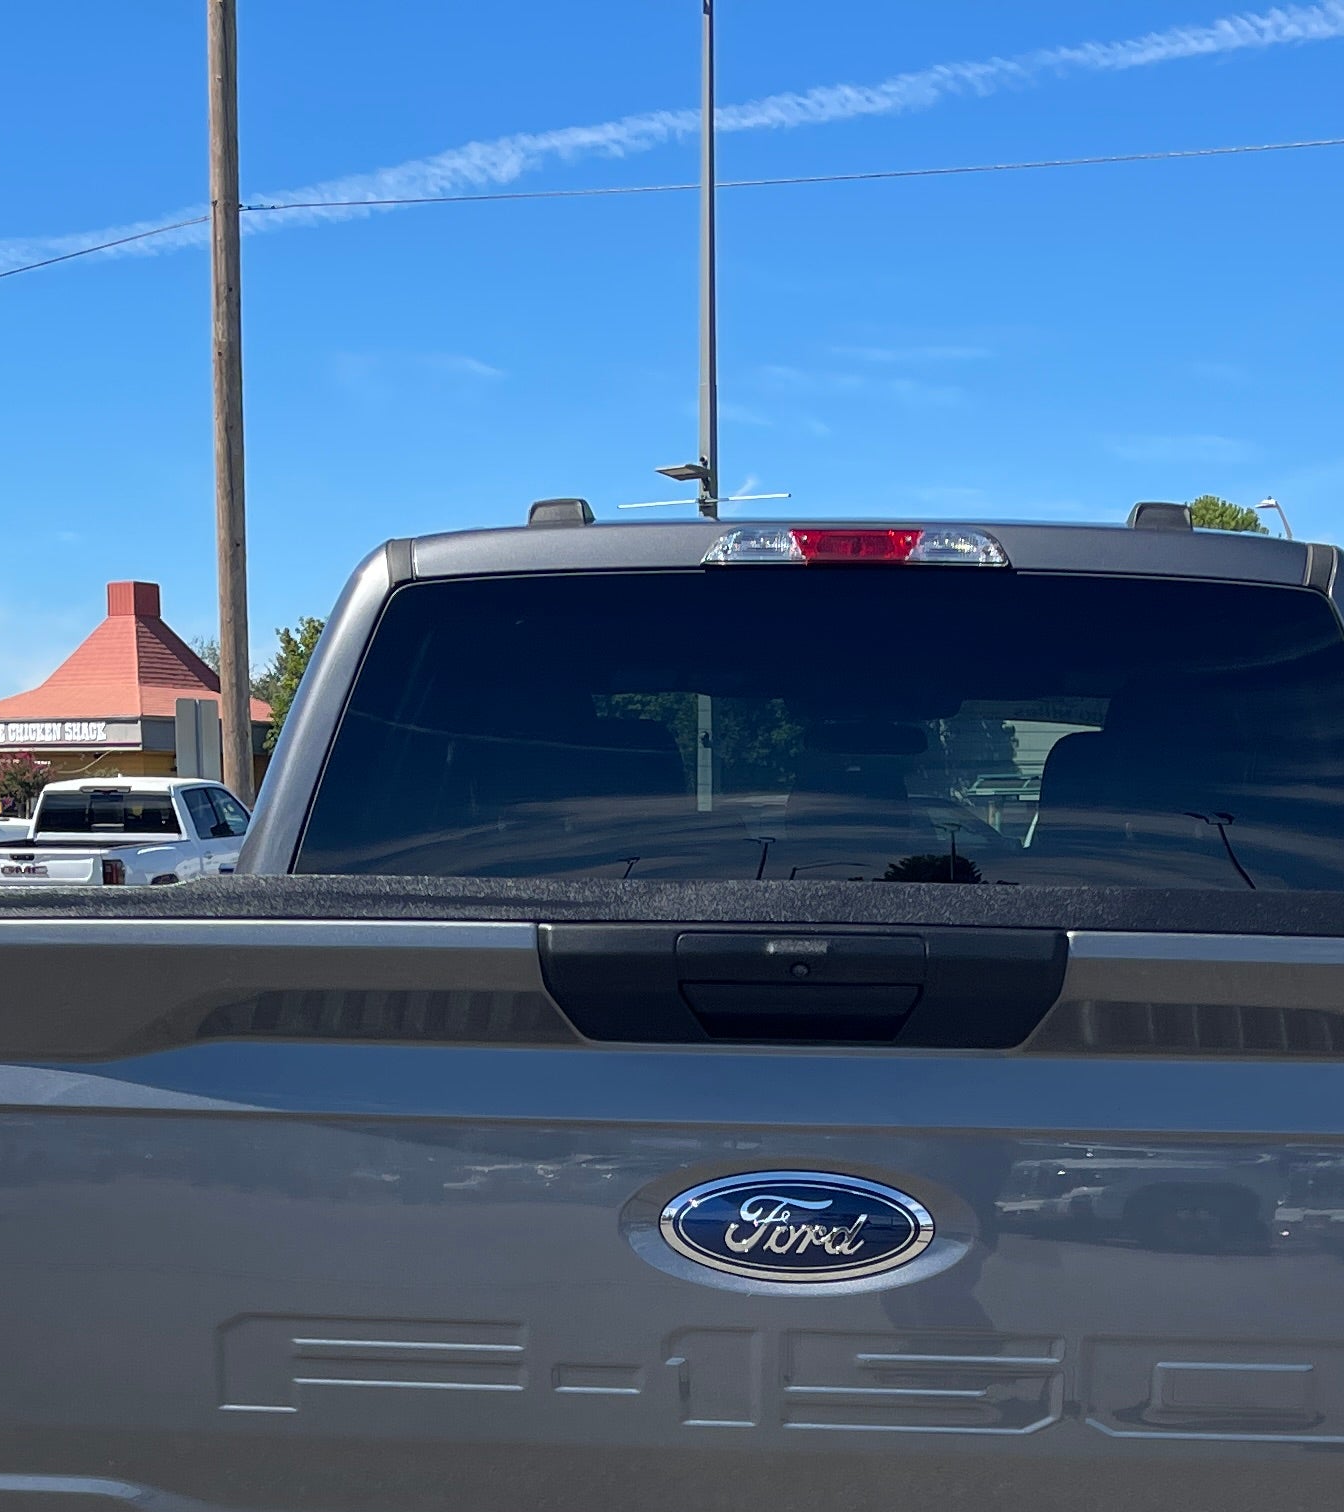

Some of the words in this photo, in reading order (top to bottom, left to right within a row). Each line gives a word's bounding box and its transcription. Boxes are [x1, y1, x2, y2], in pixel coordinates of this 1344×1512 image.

[8, 722, 61, 742] CHICKEN
[64, 721, 106, 741] SHACK
[1, 865, 48, 877] GMC
[724, 1195, 868, 1255] Ford
